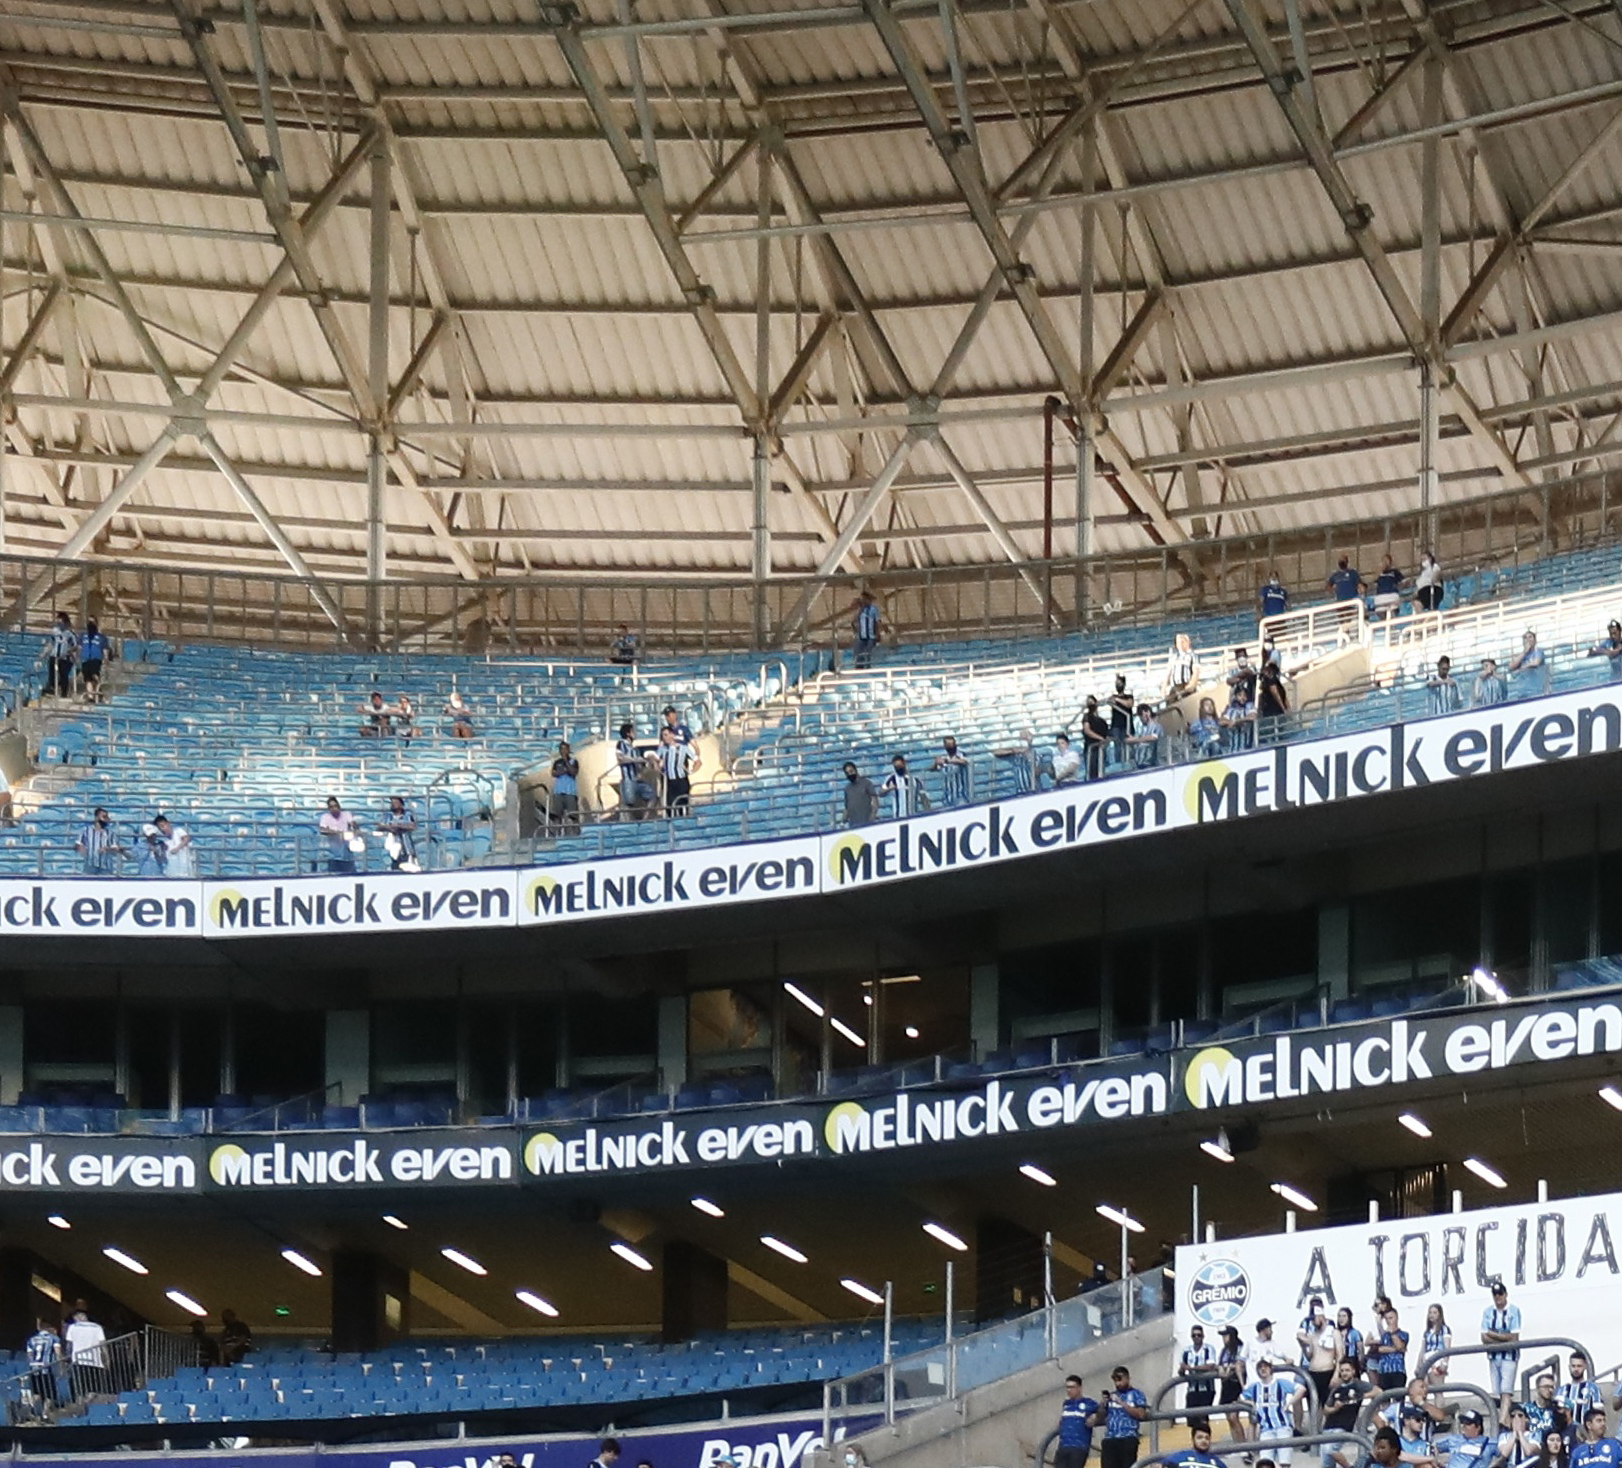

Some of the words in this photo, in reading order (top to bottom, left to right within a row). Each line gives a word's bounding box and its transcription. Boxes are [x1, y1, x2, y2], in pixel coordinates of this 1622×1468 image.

[1296, 1244, 1333, 1309] A
[1368, 1209, 1620, 1300] TORCIDA
[1192, 1281, 1250, 1305] GRÊMIO
